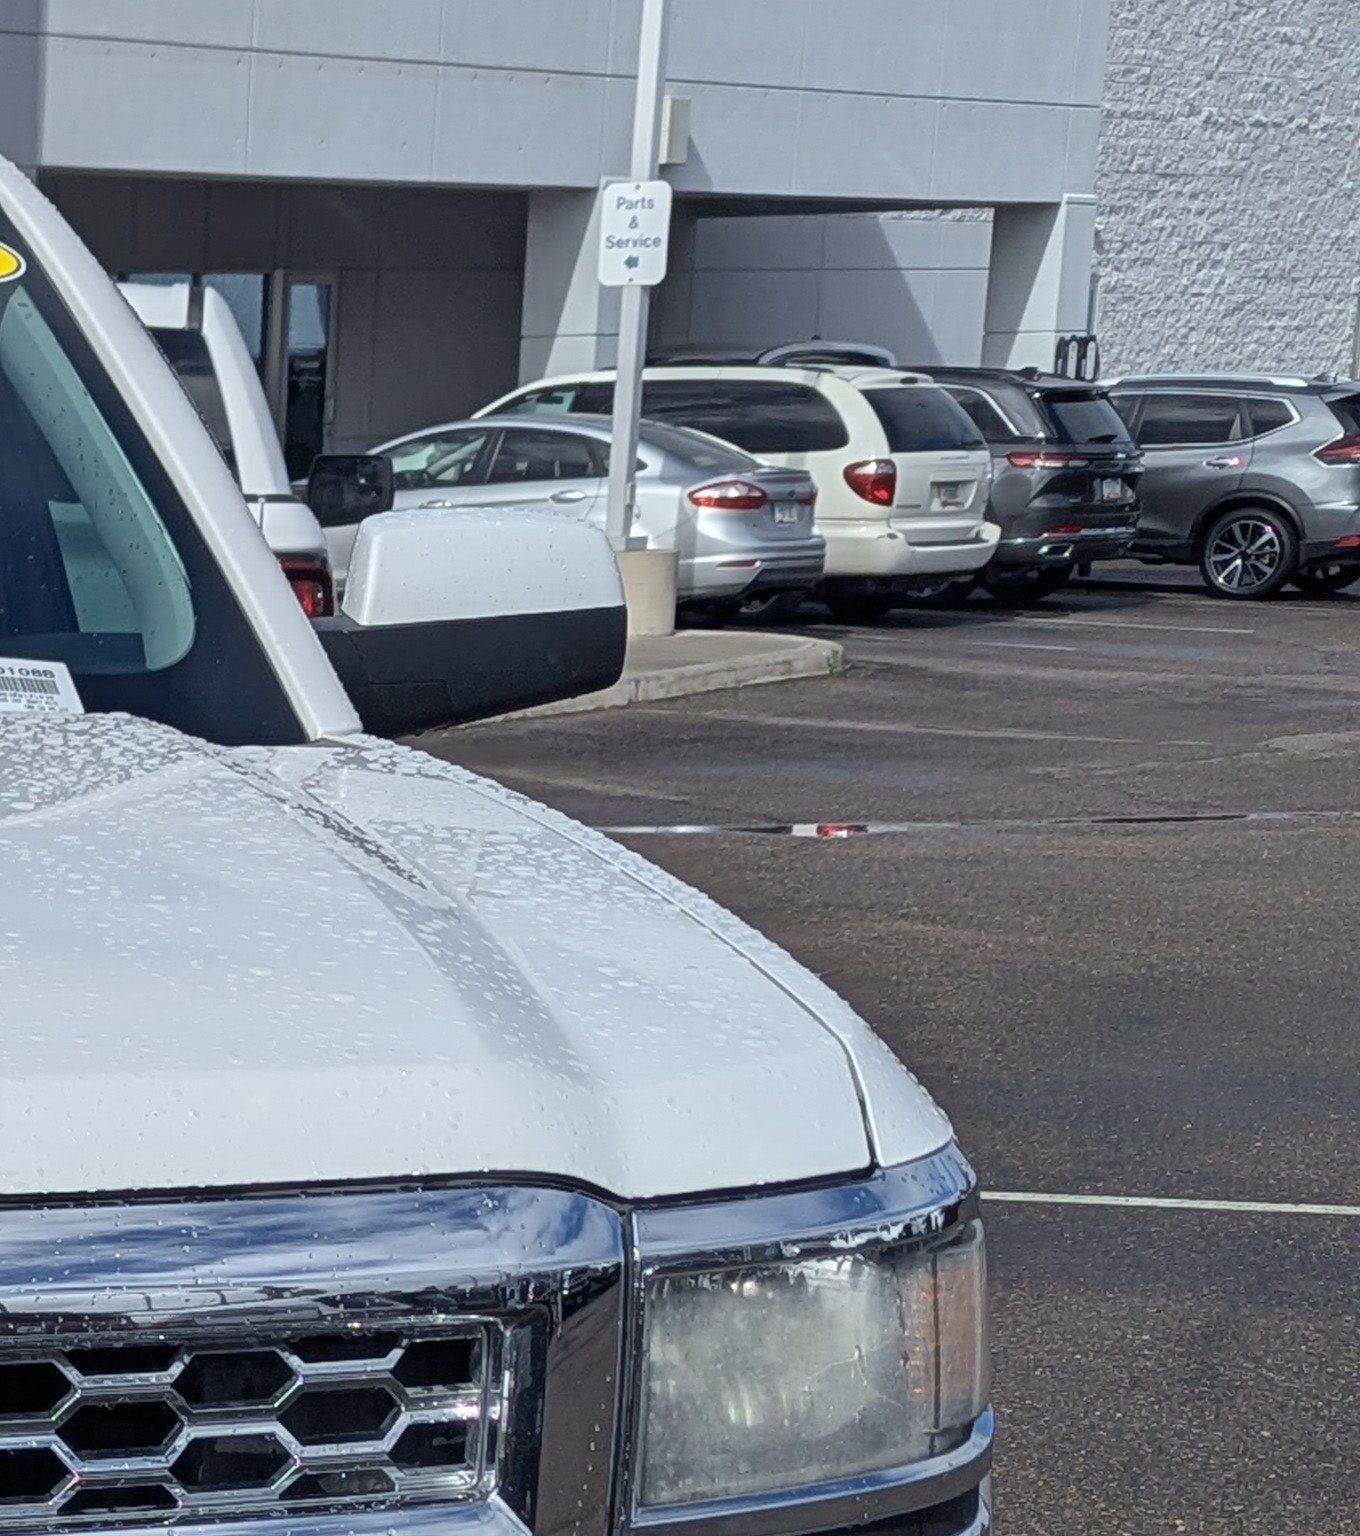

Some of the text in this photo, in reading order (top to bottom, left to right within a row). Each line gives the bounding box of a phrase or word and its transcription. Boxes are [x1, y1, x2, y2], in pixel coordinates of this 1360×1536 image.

[616, 196, 655, 210] Parts
[628, 215, 639, 229] &
[605, 234, 662, 250] Service
